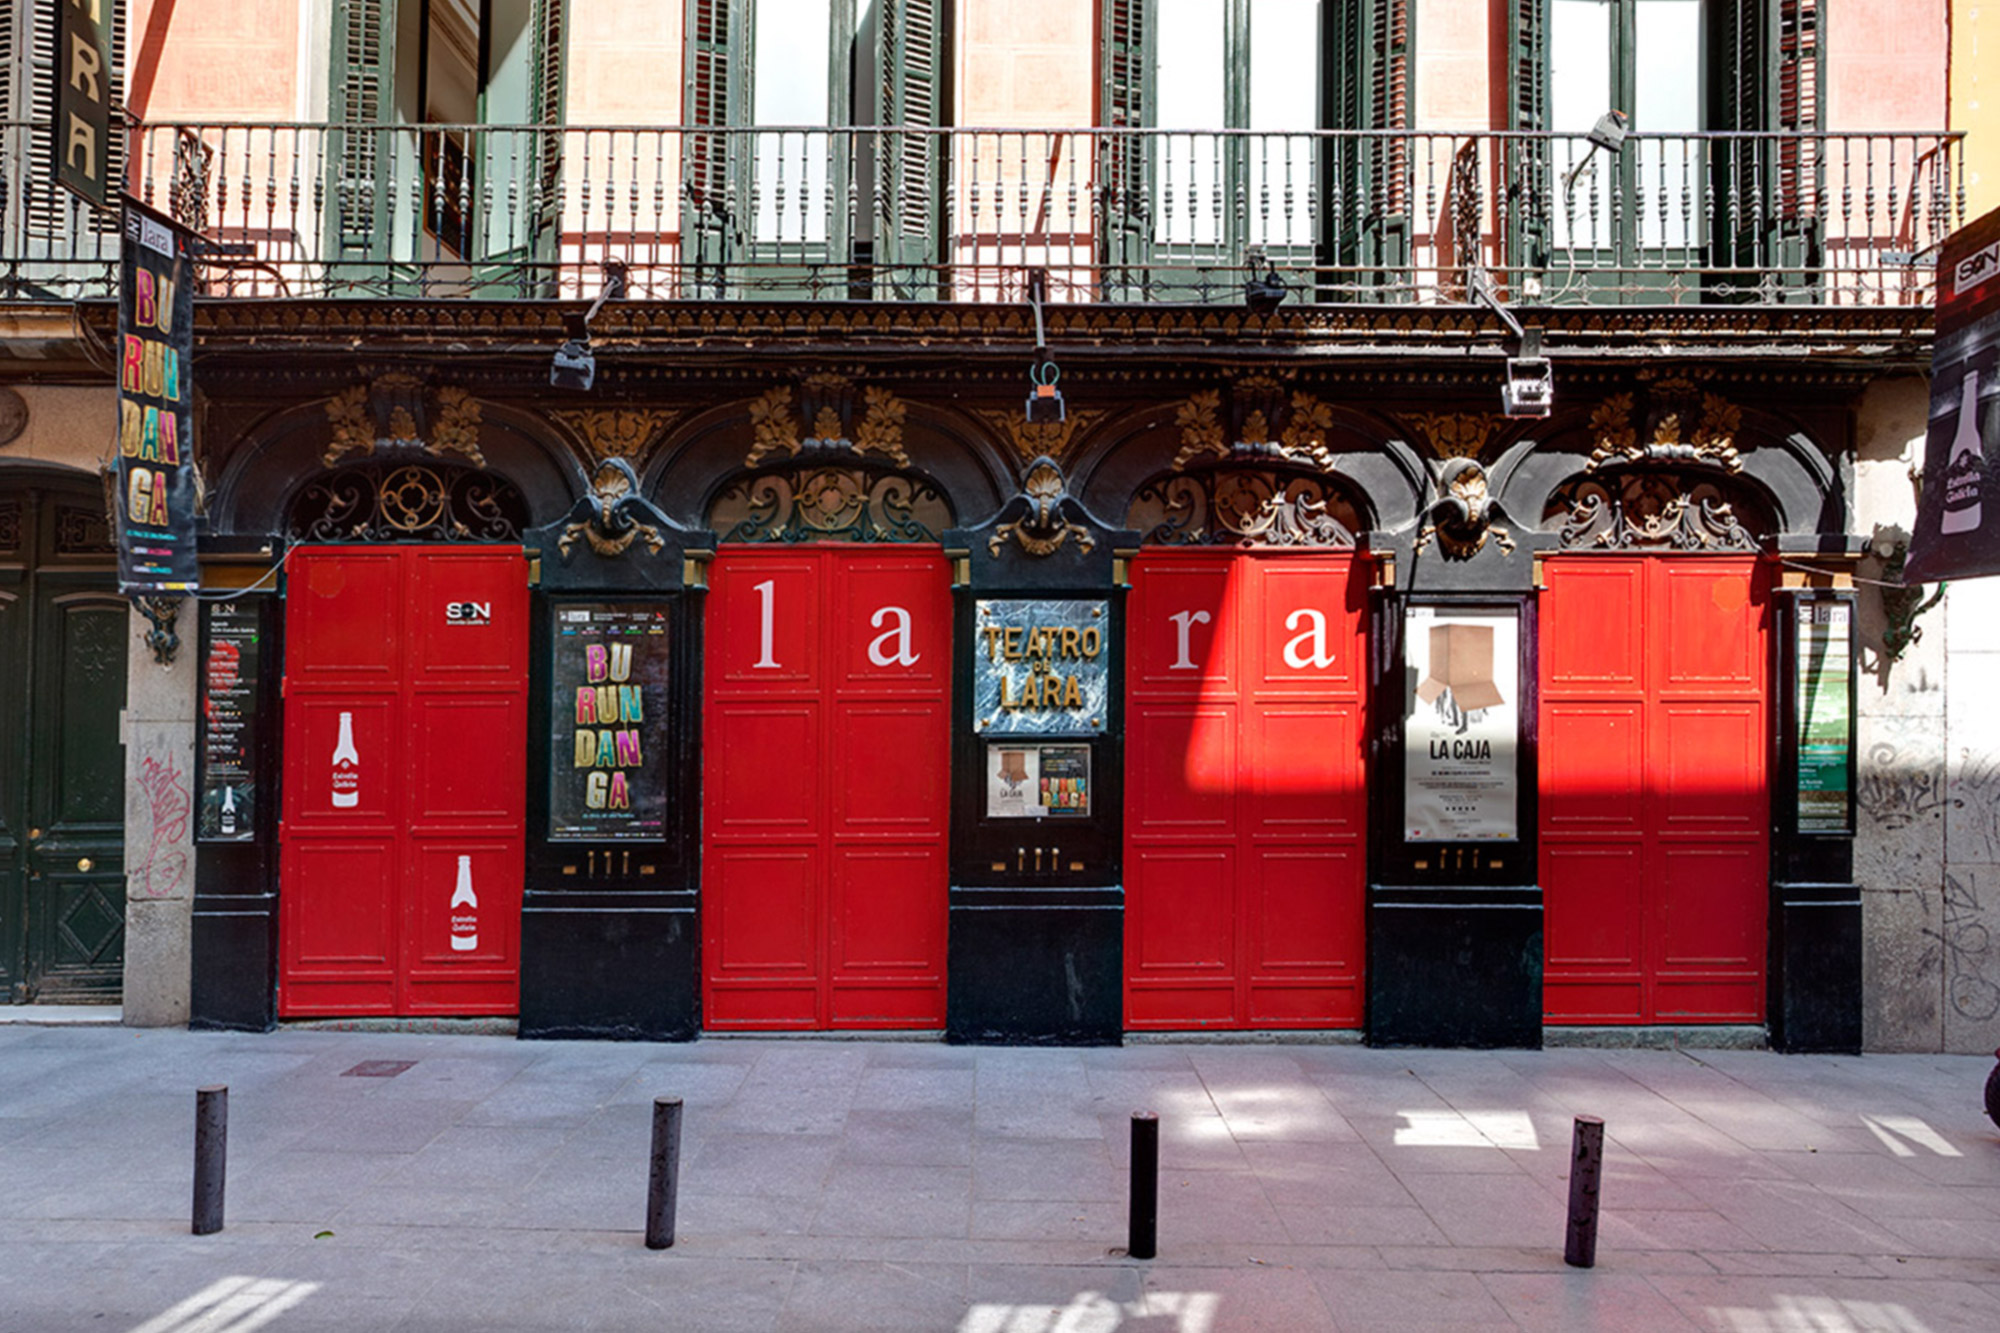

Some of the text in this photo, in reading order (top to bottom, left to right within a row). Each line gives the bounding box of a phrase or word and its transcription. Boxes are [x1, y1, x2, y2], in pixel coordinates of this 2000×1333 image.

[143, 219, 170, 253] lara
[136, 266, 176, 335] BU
[122, 332, 179, 402] RUN
[121, 398, 180, 466] DAN
[128, 467, 169, 527] GA
[585, 641, 633, 684] BU
[983, 625, 1101, 660] TEATRO
[575, 684, 643, 725] RUN
[1001, 675, 1083, 709] LARA
[574, 728, 643, 768] DAN
[1429, 739, 1491, 760] LA CAJA
[586, 771, 630, 809] GA
